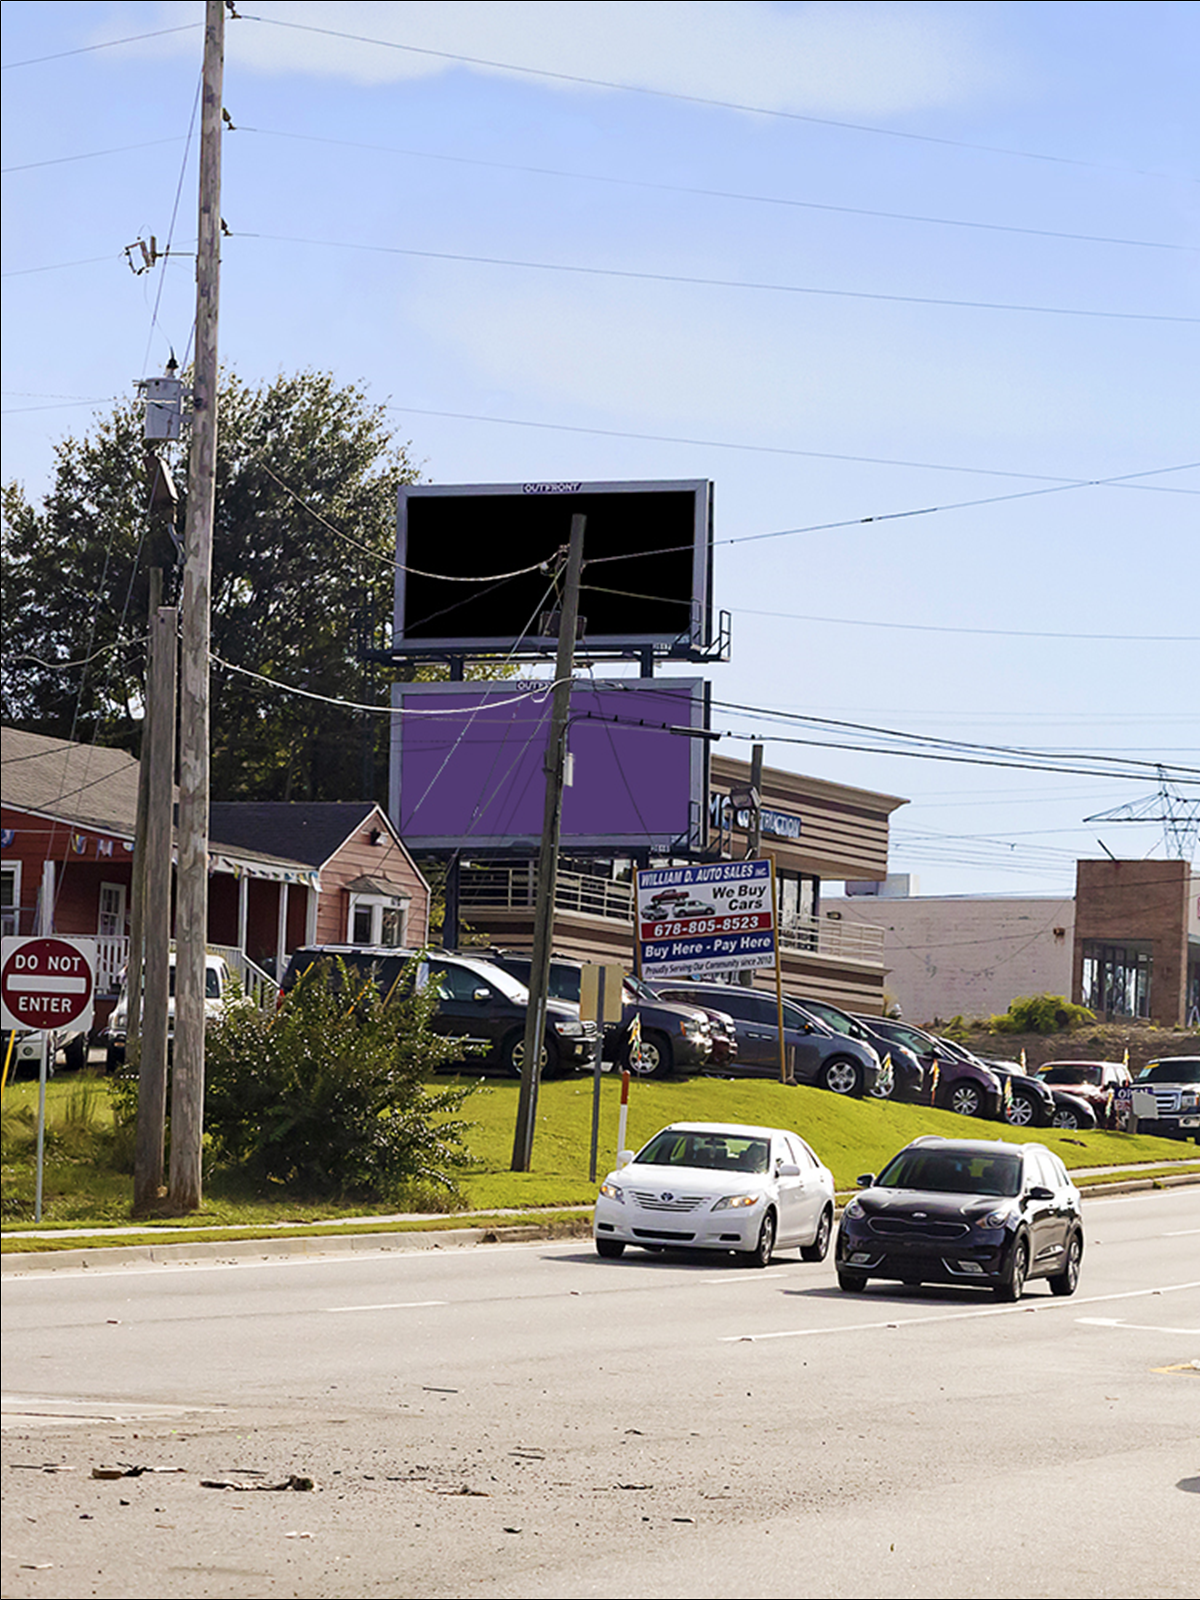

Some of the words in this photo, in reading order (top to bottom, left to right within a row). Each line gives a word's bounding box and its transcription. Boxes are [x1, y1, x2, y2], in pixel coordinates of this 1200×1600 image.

[737, 808, 801, 838] COTRUCTION
[641, 870, 682, 887] WILLIAM
[684, 870, 693, 882] D.
[696, 867, 722, 882] AUTO
[723, 864, 754, 880] SALES
[712, 887, 735, 899] We
[738, 885, 767, 898] Buy
[728, 898, 763, 911] Cars
[654, 916, 759, 937] 678-805-8523
[645, 945, 669, 959] Buy
[672, 943, 703, 956] Here
[713, 940, 738, 953] Pay
[740, 937, 771, 949] Here
[15, 954, 39, 970] DO
[47, 956, 81, 971] NOT
[645, 965, 669, 975] Proudly
[669, 963, 692, 973] Serving
[693, 962, 704, 971] Our
[705, 959, 739, 970] Community
[18, 996, 72, 1013] ENTER
